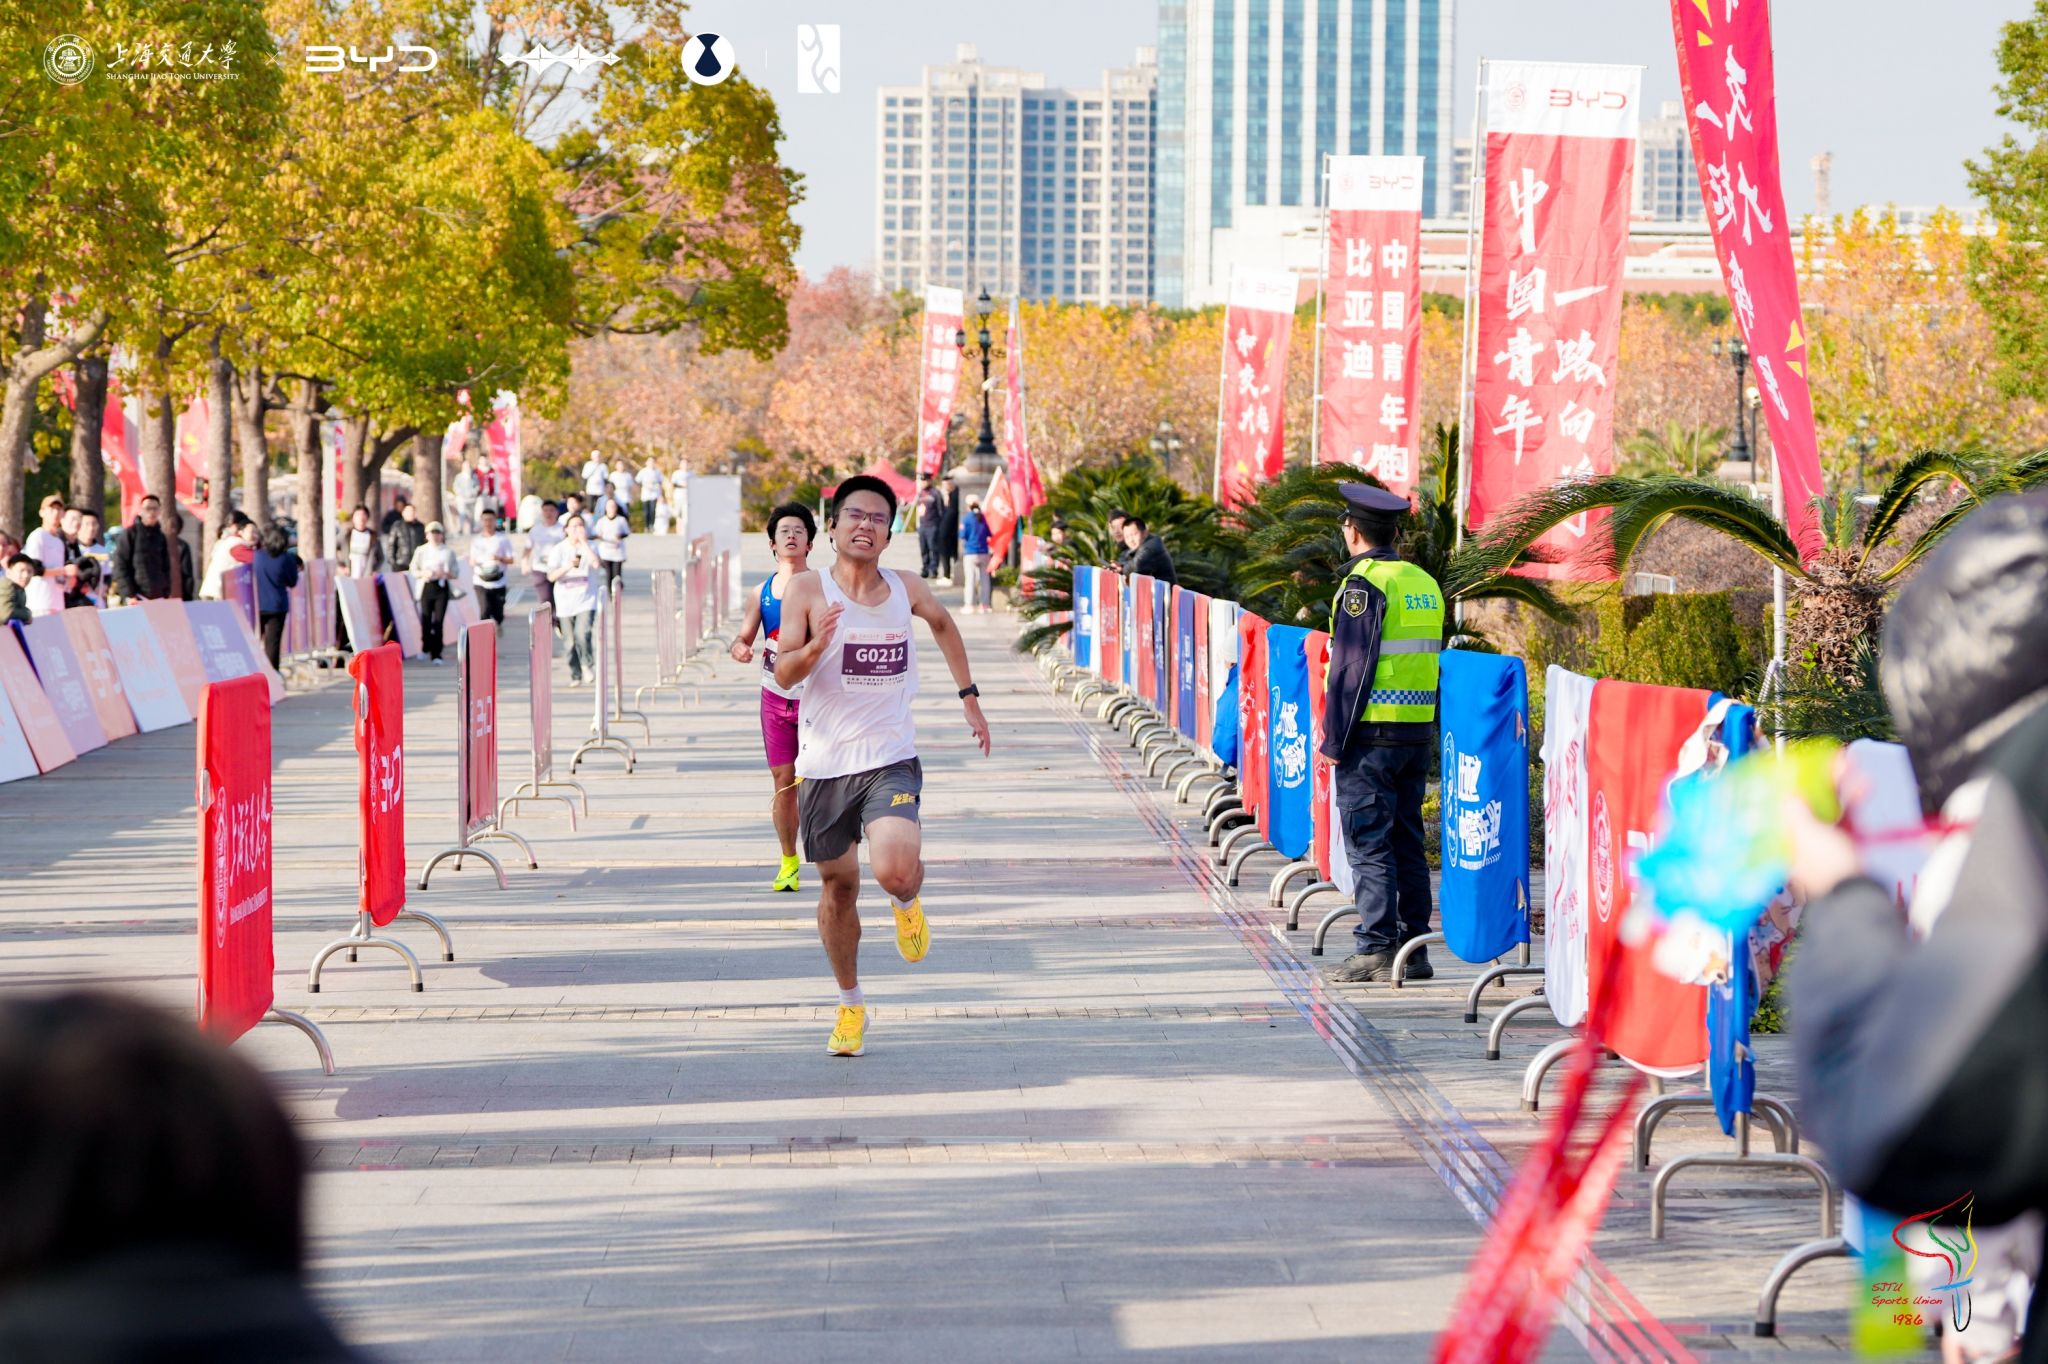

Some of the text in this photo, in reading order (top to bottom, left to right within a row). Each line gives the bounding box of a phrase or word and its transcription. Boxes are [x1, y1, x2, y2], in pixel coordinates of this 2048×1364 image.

[1549, 89, 1627, 110] BYD
[1368, 175, 1414, 191] BYD
[1342, 238, 1374, 381] 比亚迪
[1405, 593, 1438, 611] 交大保卫
[856, 646, 904, 663] G0212
